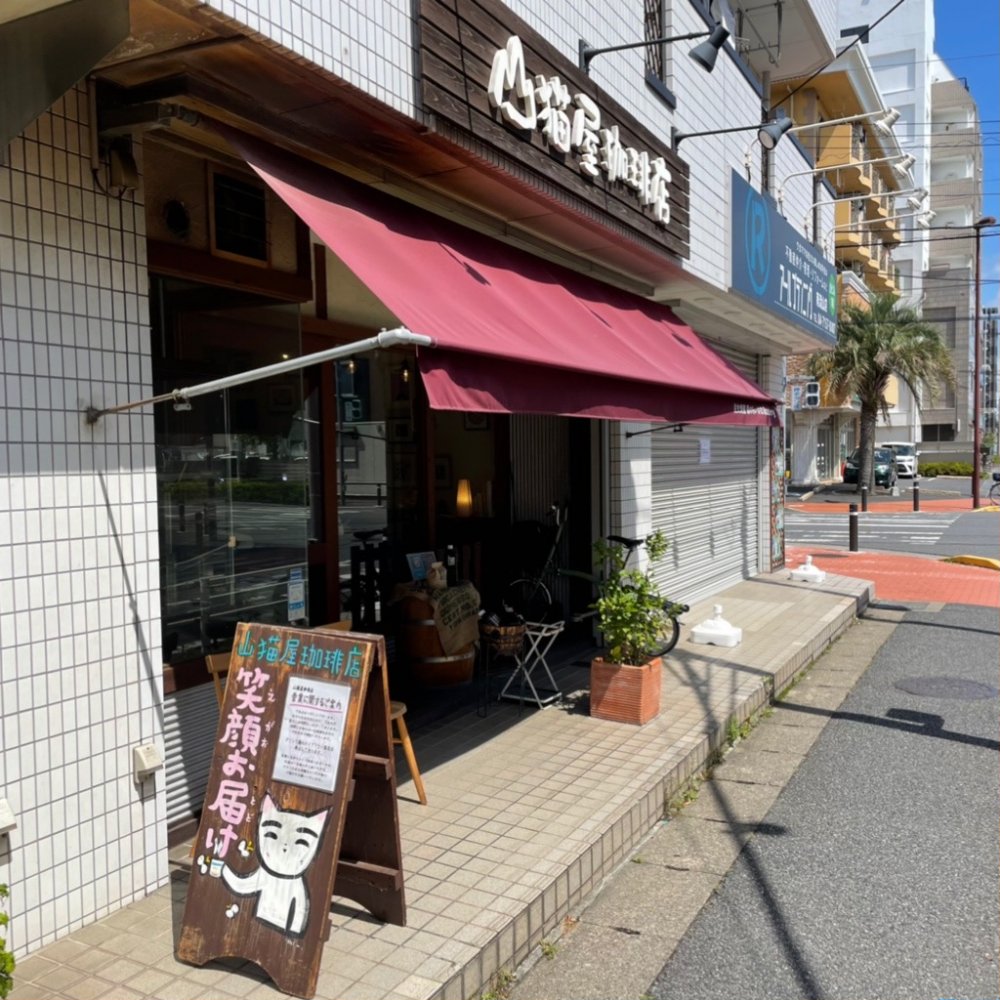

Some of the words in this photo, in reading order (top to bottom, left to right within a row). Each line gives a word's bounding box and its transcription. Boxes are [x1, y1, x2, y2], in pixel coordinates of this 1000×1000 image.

[487, 35, 672, 225] 山猫屋珈琲店
[236, 630, 363, 680] 山猫屋珈琲店
[204, 666, 270, 858] 笑顔お届け
